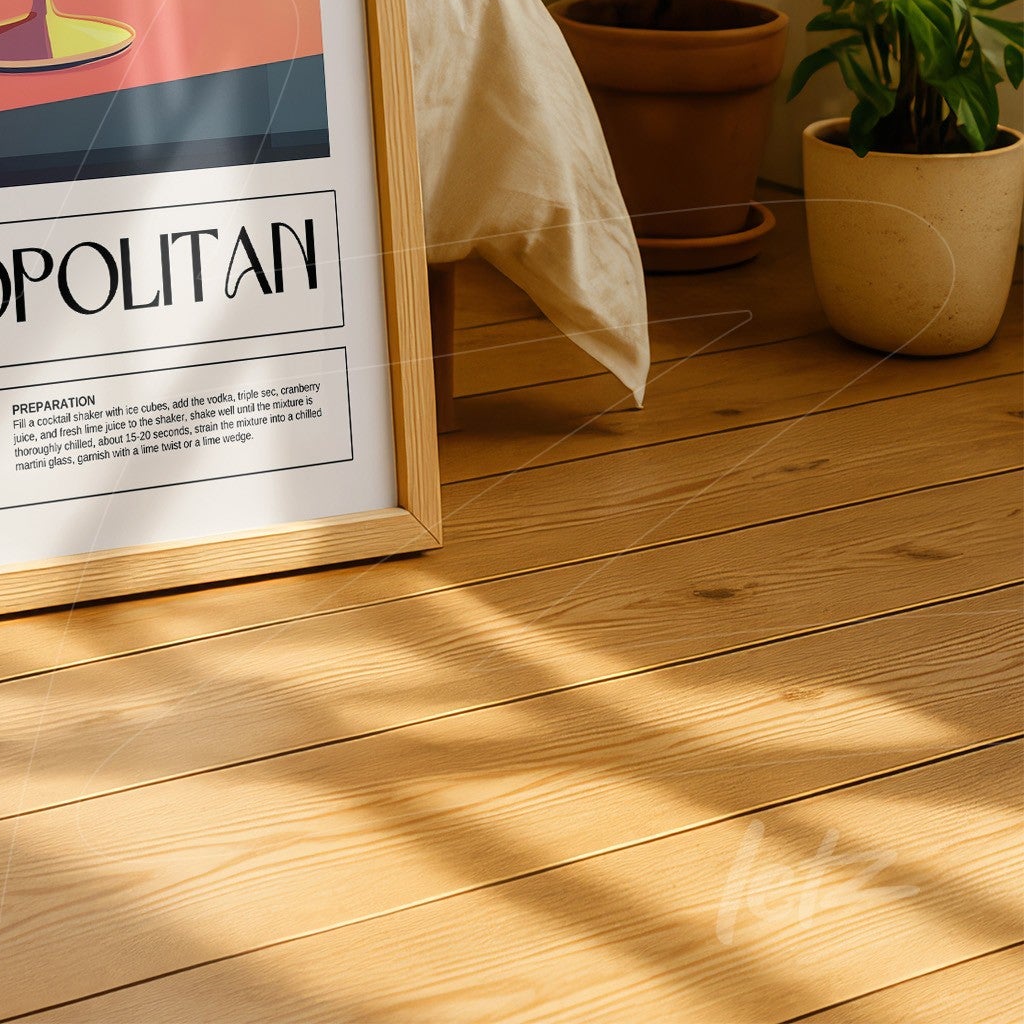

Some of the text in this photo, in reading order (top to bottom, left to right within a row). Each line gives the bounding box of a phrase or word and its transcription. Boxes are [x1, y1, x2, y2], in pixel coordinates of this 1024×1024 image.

[12, 394, 95, 415] PREPARATION
[13, 383, 320, 429] Fill a cocktail shaker with ice cubes, add the vodka, triple sec, cranberry
[13, 395, 313, 445] juice, and fresh lime juice to the shaker, shake well until the mixture is
[14, 407, 322, 457] thoroughly chilled, about 15-20 seconds, strain the mixture into a chilled
[15, 432, 253, 470] martini glass, garnish with a lime twist or a lime wedge.
